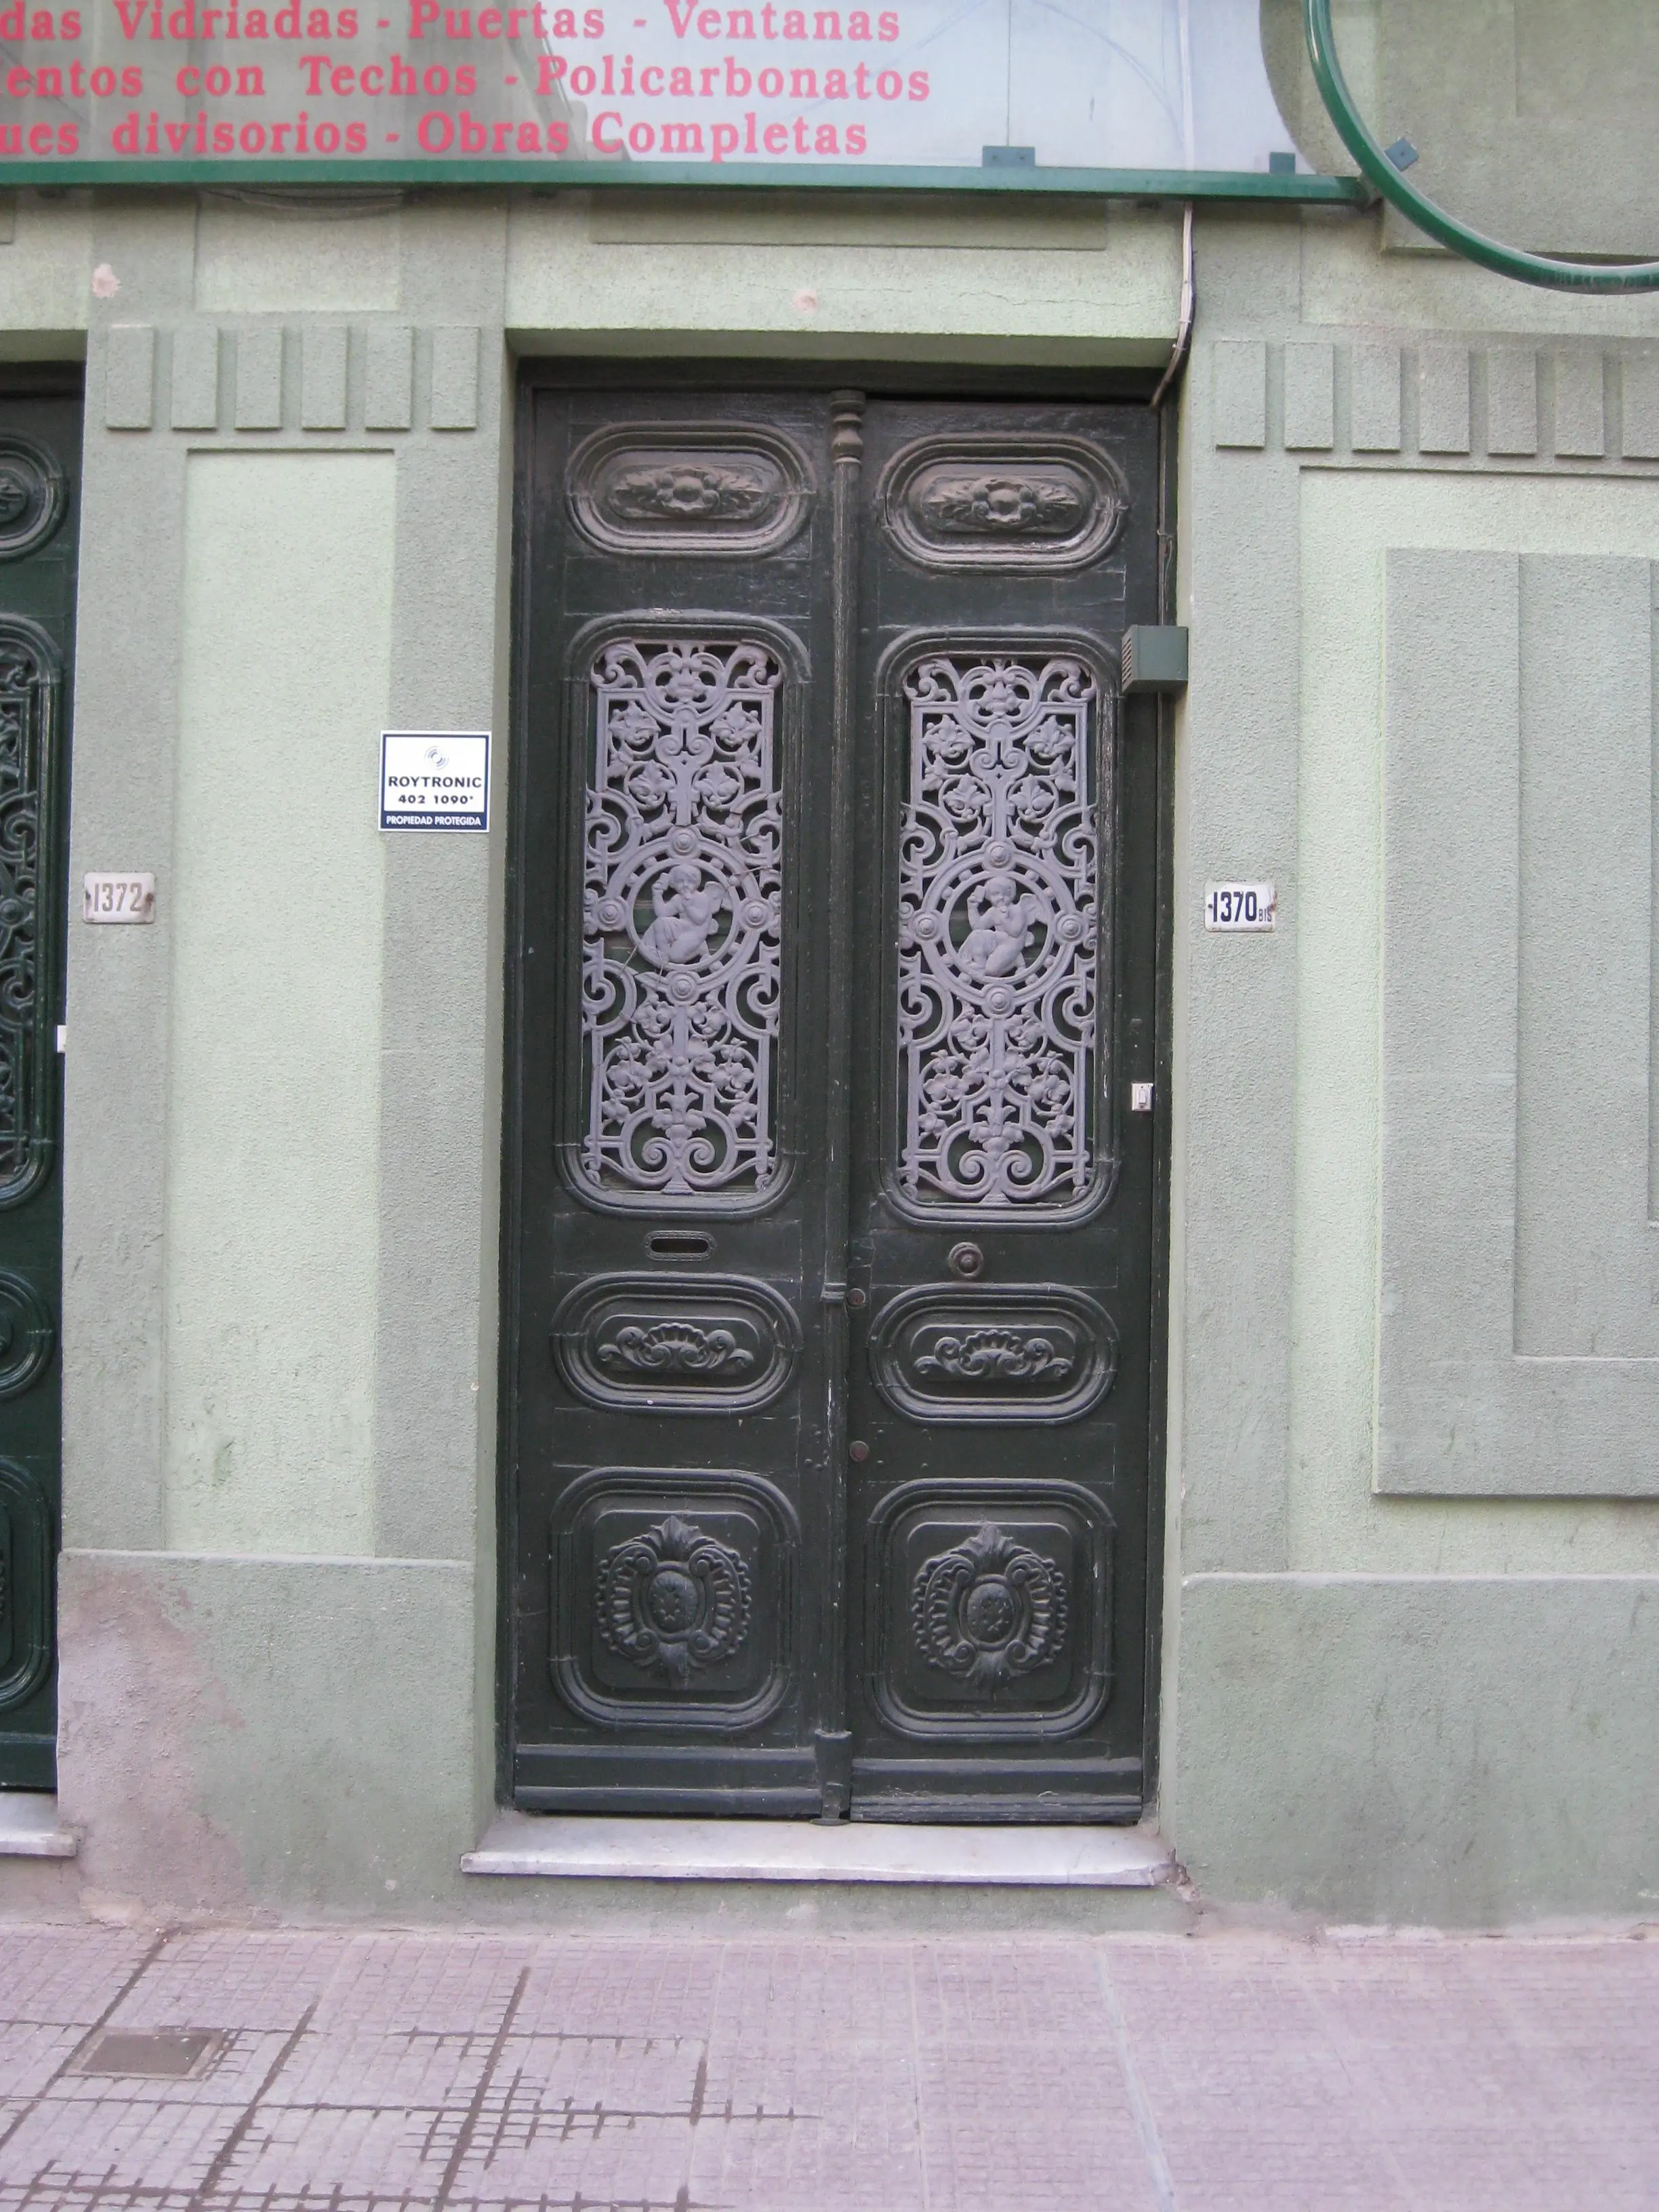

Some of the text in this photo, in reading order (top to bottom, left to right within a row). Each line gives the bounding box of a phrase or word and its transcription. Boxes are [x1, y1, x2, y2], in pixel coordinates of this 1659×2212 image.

[0, 0, 82, 41] das
[112, 0, 359, 41] Vidriadas
[408, 0, 605, 41] Puertas
[663, 0, 899, 42] Ventanas
[0, 58, 143, 98] entos
[175, 64, 266, 97] con
[298, 54, 478, 97] Techos
[535, 54, 930, 101] Policarbonatos
[111, 110, 368, 155] divisorios
[417, 109, 570, 153] Obras
[591, 110, 867, 163] Completas
[388, 776, 482, 788] ROYTRONIC
[398, 794, 426, 804] 402
[386, 815, 482, 826] PROPIEDAD PROTEGIDA
[94, 882, 142, 912] 1372
[1212, 890, 1257, 922] 1370
